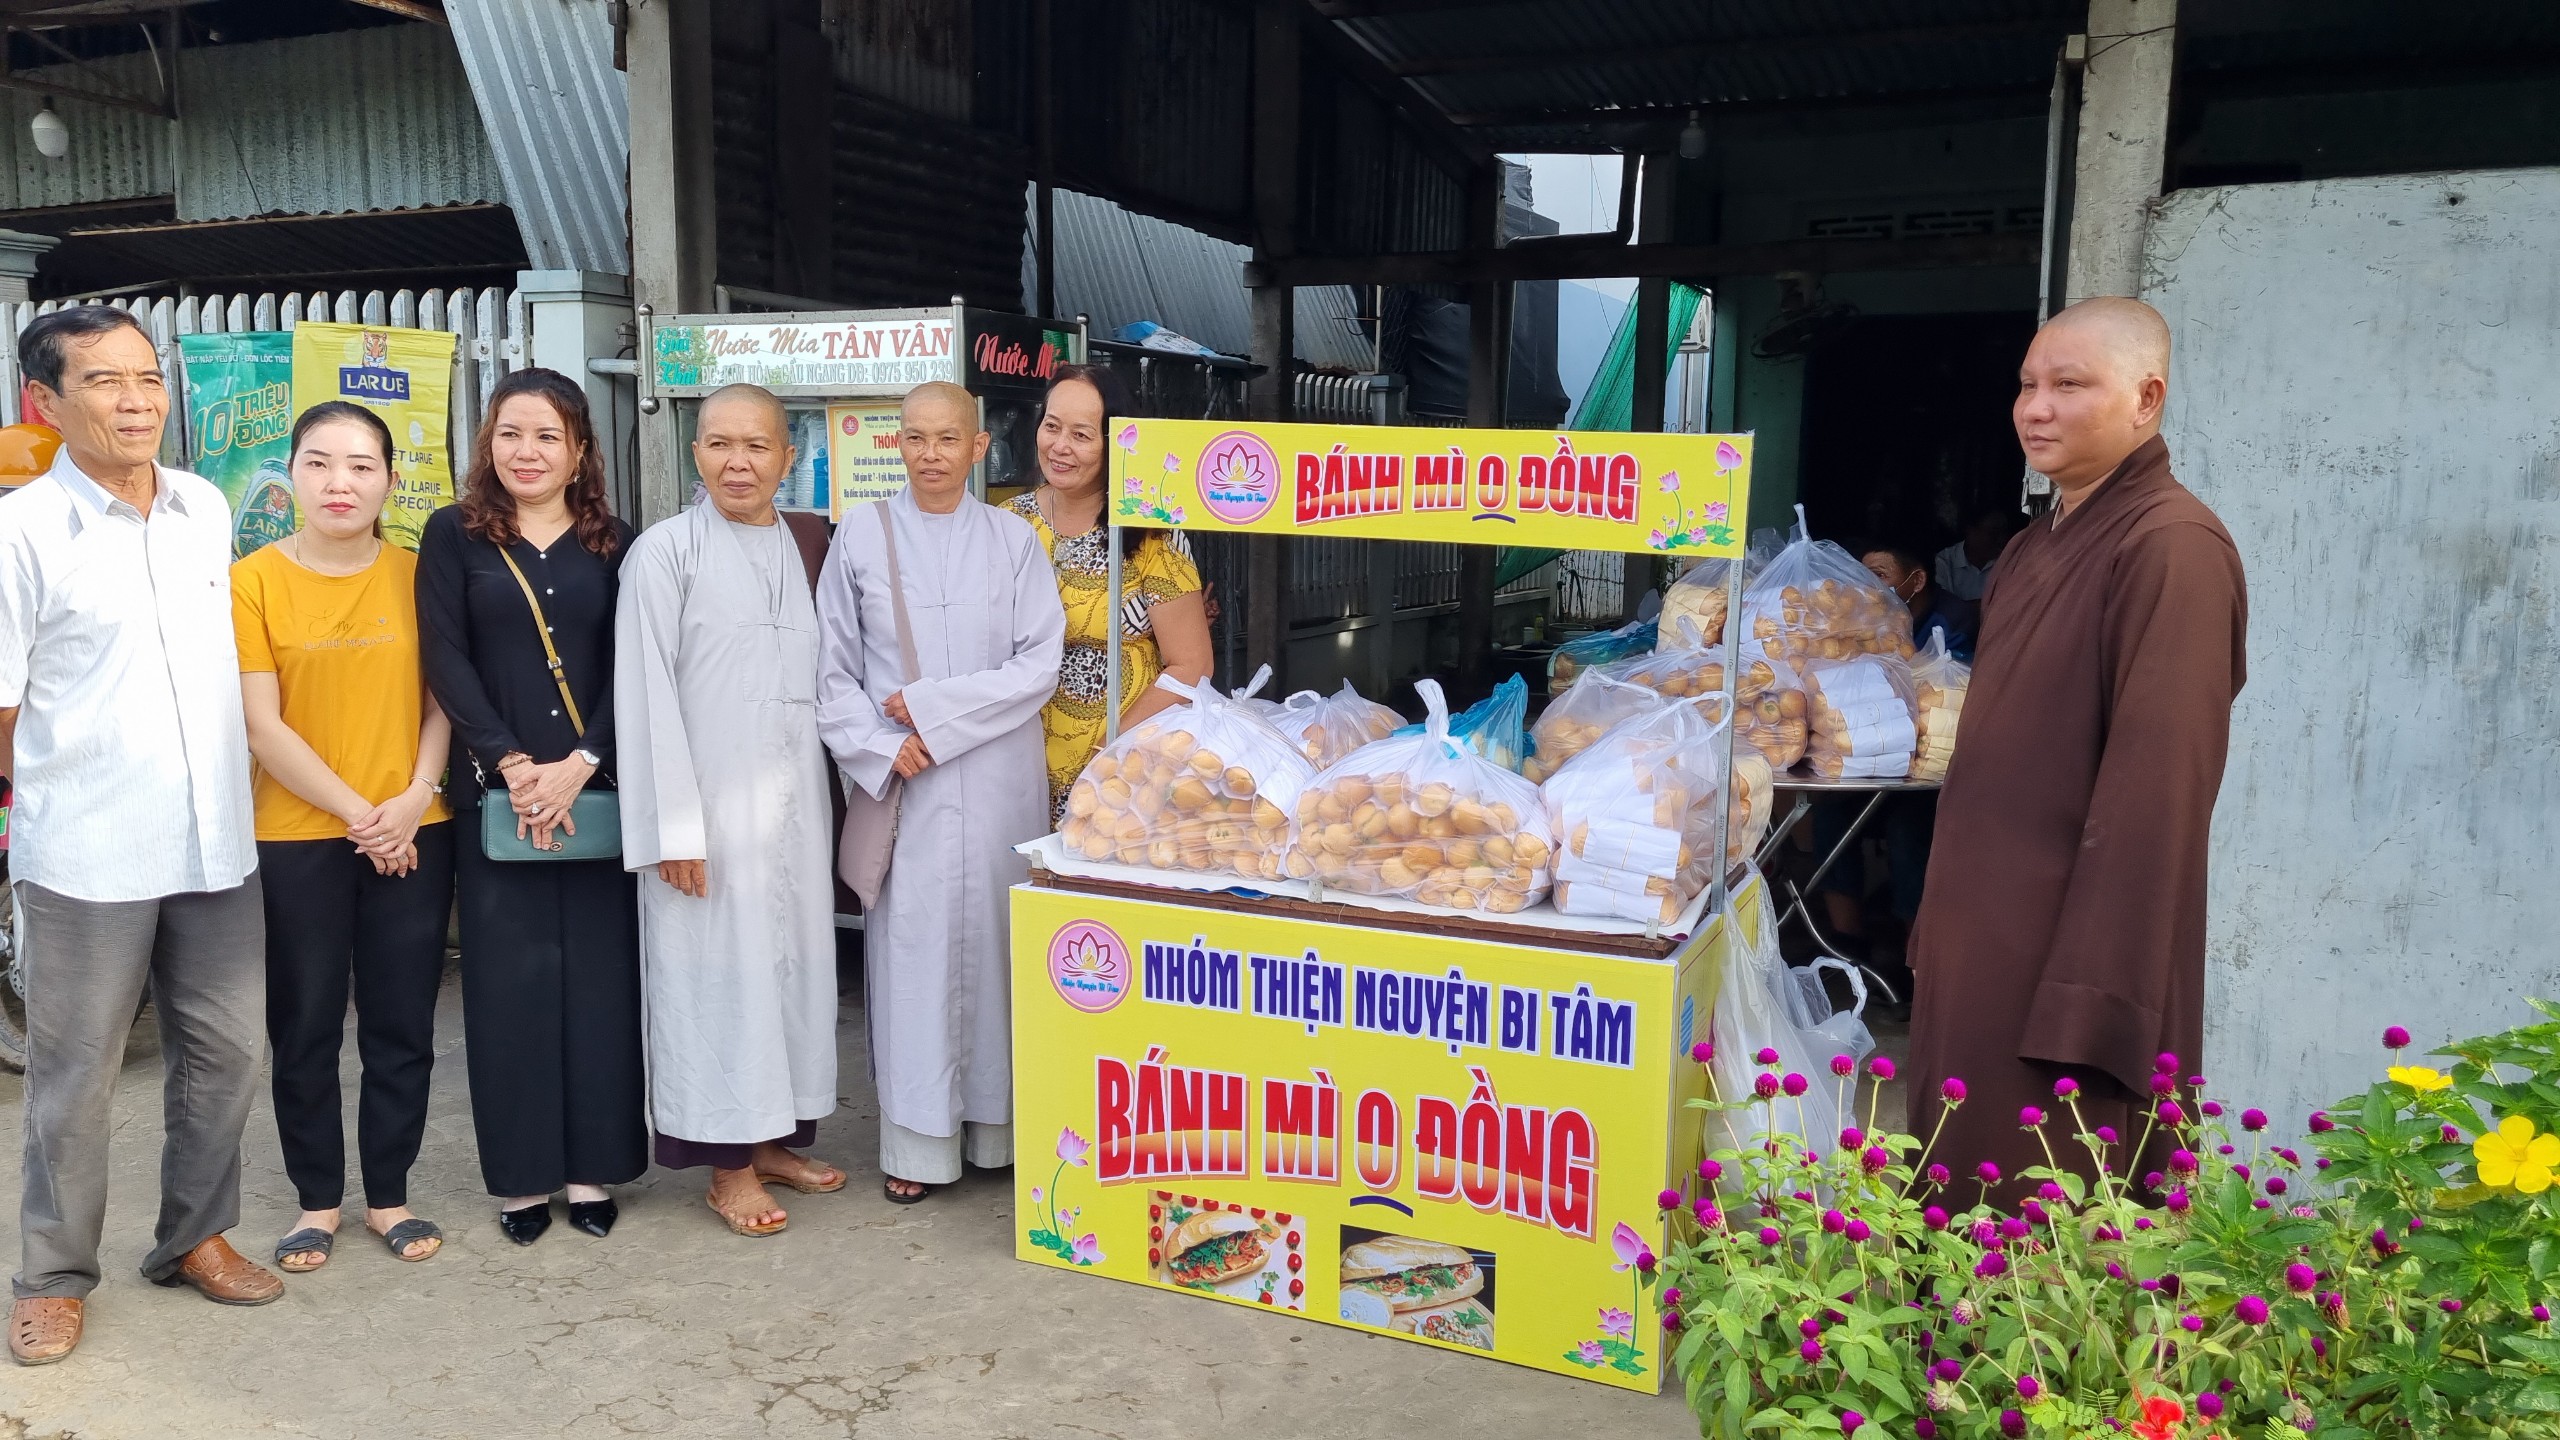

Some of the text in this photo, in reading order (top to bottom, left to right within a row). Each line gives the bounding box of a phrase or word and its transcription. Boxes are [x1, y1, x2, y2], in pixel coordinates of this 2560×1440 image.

[706, 321, 953, 359] Nước Mía TÂN VÂN
[974, 332, 1028, 376] Nước
[345, 373, 405, 393] LARUE
[806, 363, 846, 384] NGANG
[871, 361, 900, 384] 0975
[904, 361, 926, 382] 950
[930, 359, 953, 381] 239
[195, 400, 234, 459] 10
[872, 432, 900, 450] THÔN
[409, 451, 433, 465] LARUE
[411, 480, 441, 495] LARUE
[1294, 443, 1403, 525] BÁNH
[1412, 446, 1468, 512] MÌ
[1517, 436, 1640, 524] ĐỒNG
[1143, 936, 1635, 1067] NHÓM THIỆN NGUYỆN BI TÂM
[1097, 1045, 1247, 1183] BÁNH
[1263, 1068, 1338, 1182] MÌ
[1413, 1066, 1596, 1238] ĐỒNG
